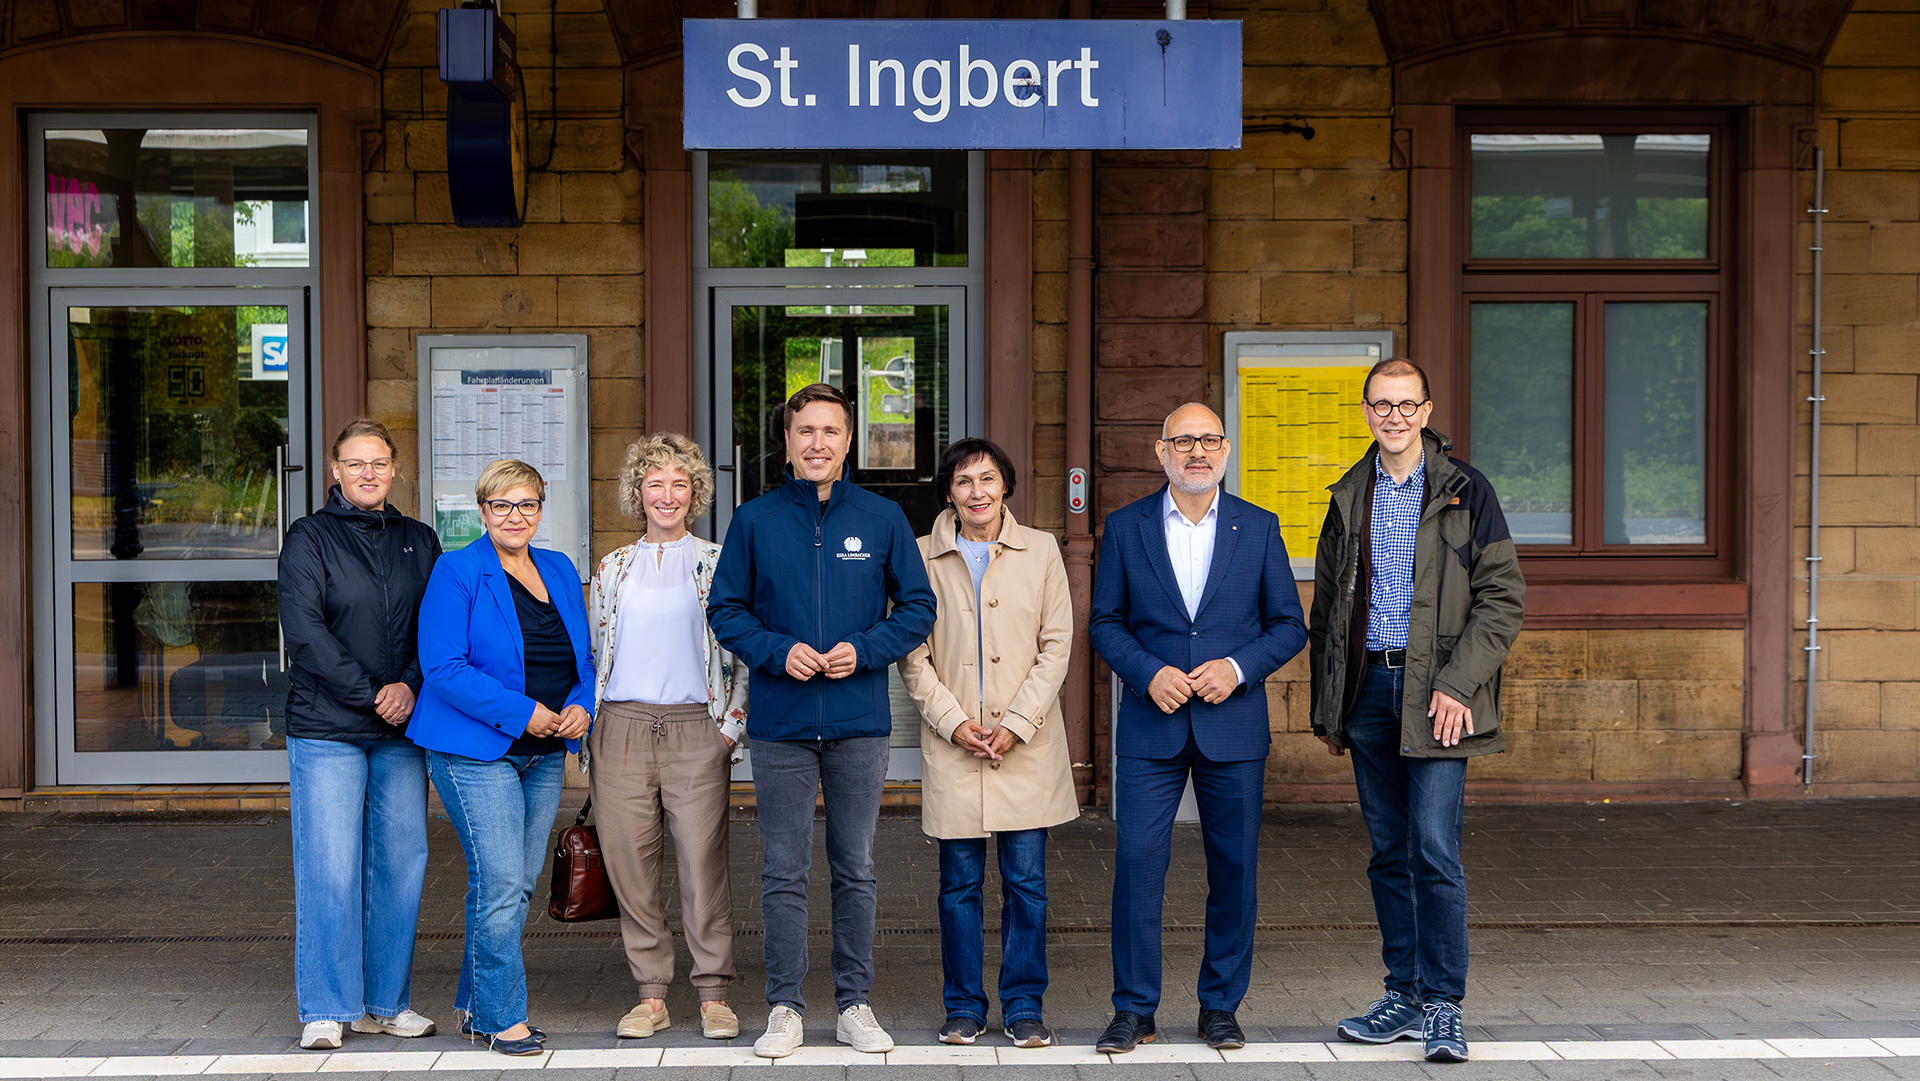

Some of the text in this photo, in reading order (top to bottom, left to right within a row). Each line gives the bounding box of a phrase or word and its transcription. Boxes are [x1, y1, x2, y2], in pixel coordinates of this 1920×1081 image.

[726, 42, 1099, 123] St. Ingbert
[167, 335, 203, 347] LOTTO
[168, 350, 206, 360] Jackpot
[467, 376, 545, 385] Fahrplanänderungen
